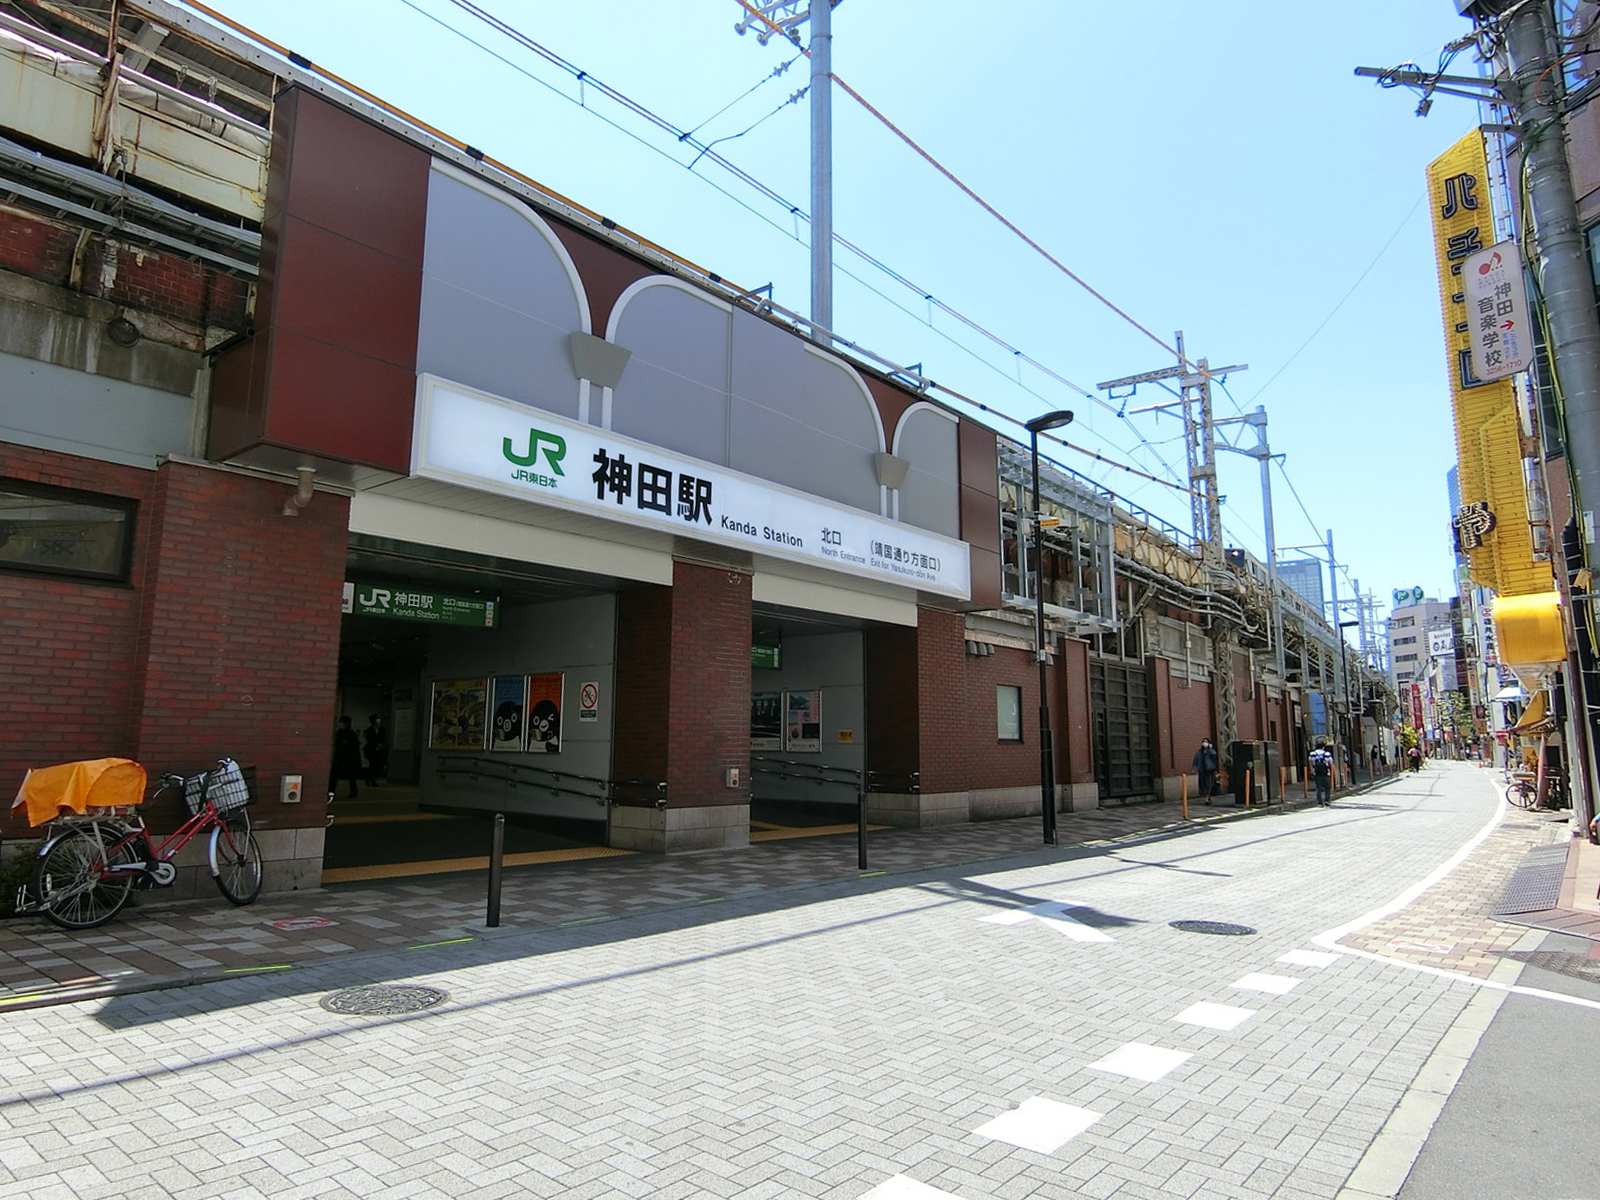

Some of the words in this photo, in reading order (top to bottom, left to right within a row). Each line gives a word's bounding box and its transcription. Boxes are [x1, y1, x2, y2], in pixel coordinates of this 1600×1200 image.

[1494, 282, 1514, 317] 神田
[1477, 296, 1502, 367] 音楽学校
[1486, 360, 1522, 375] 3256-1710
[503, 427, 567, 477] JR
[511, 468, 558, 489] JR東日本
[592, 447, 713, 526] 神田駅
[721, 515, 757, 537] Kanda
[763, 526, 803, 548] Station
[821, 527, 842, 546] 北口
[821, 545, 839, 557] North
[841, 551, 866, 565] Entrance
[870, 557, 880, 568] Exit
[881, 559, 889, 570] for
[359, 588, 391, 609] JR
[395, 591, 434, 609] 神田駅
[443, 597, 456, 606] 北口
[392, 608, 416, 618] Kanda
[416, 610, 440, 620] Station
